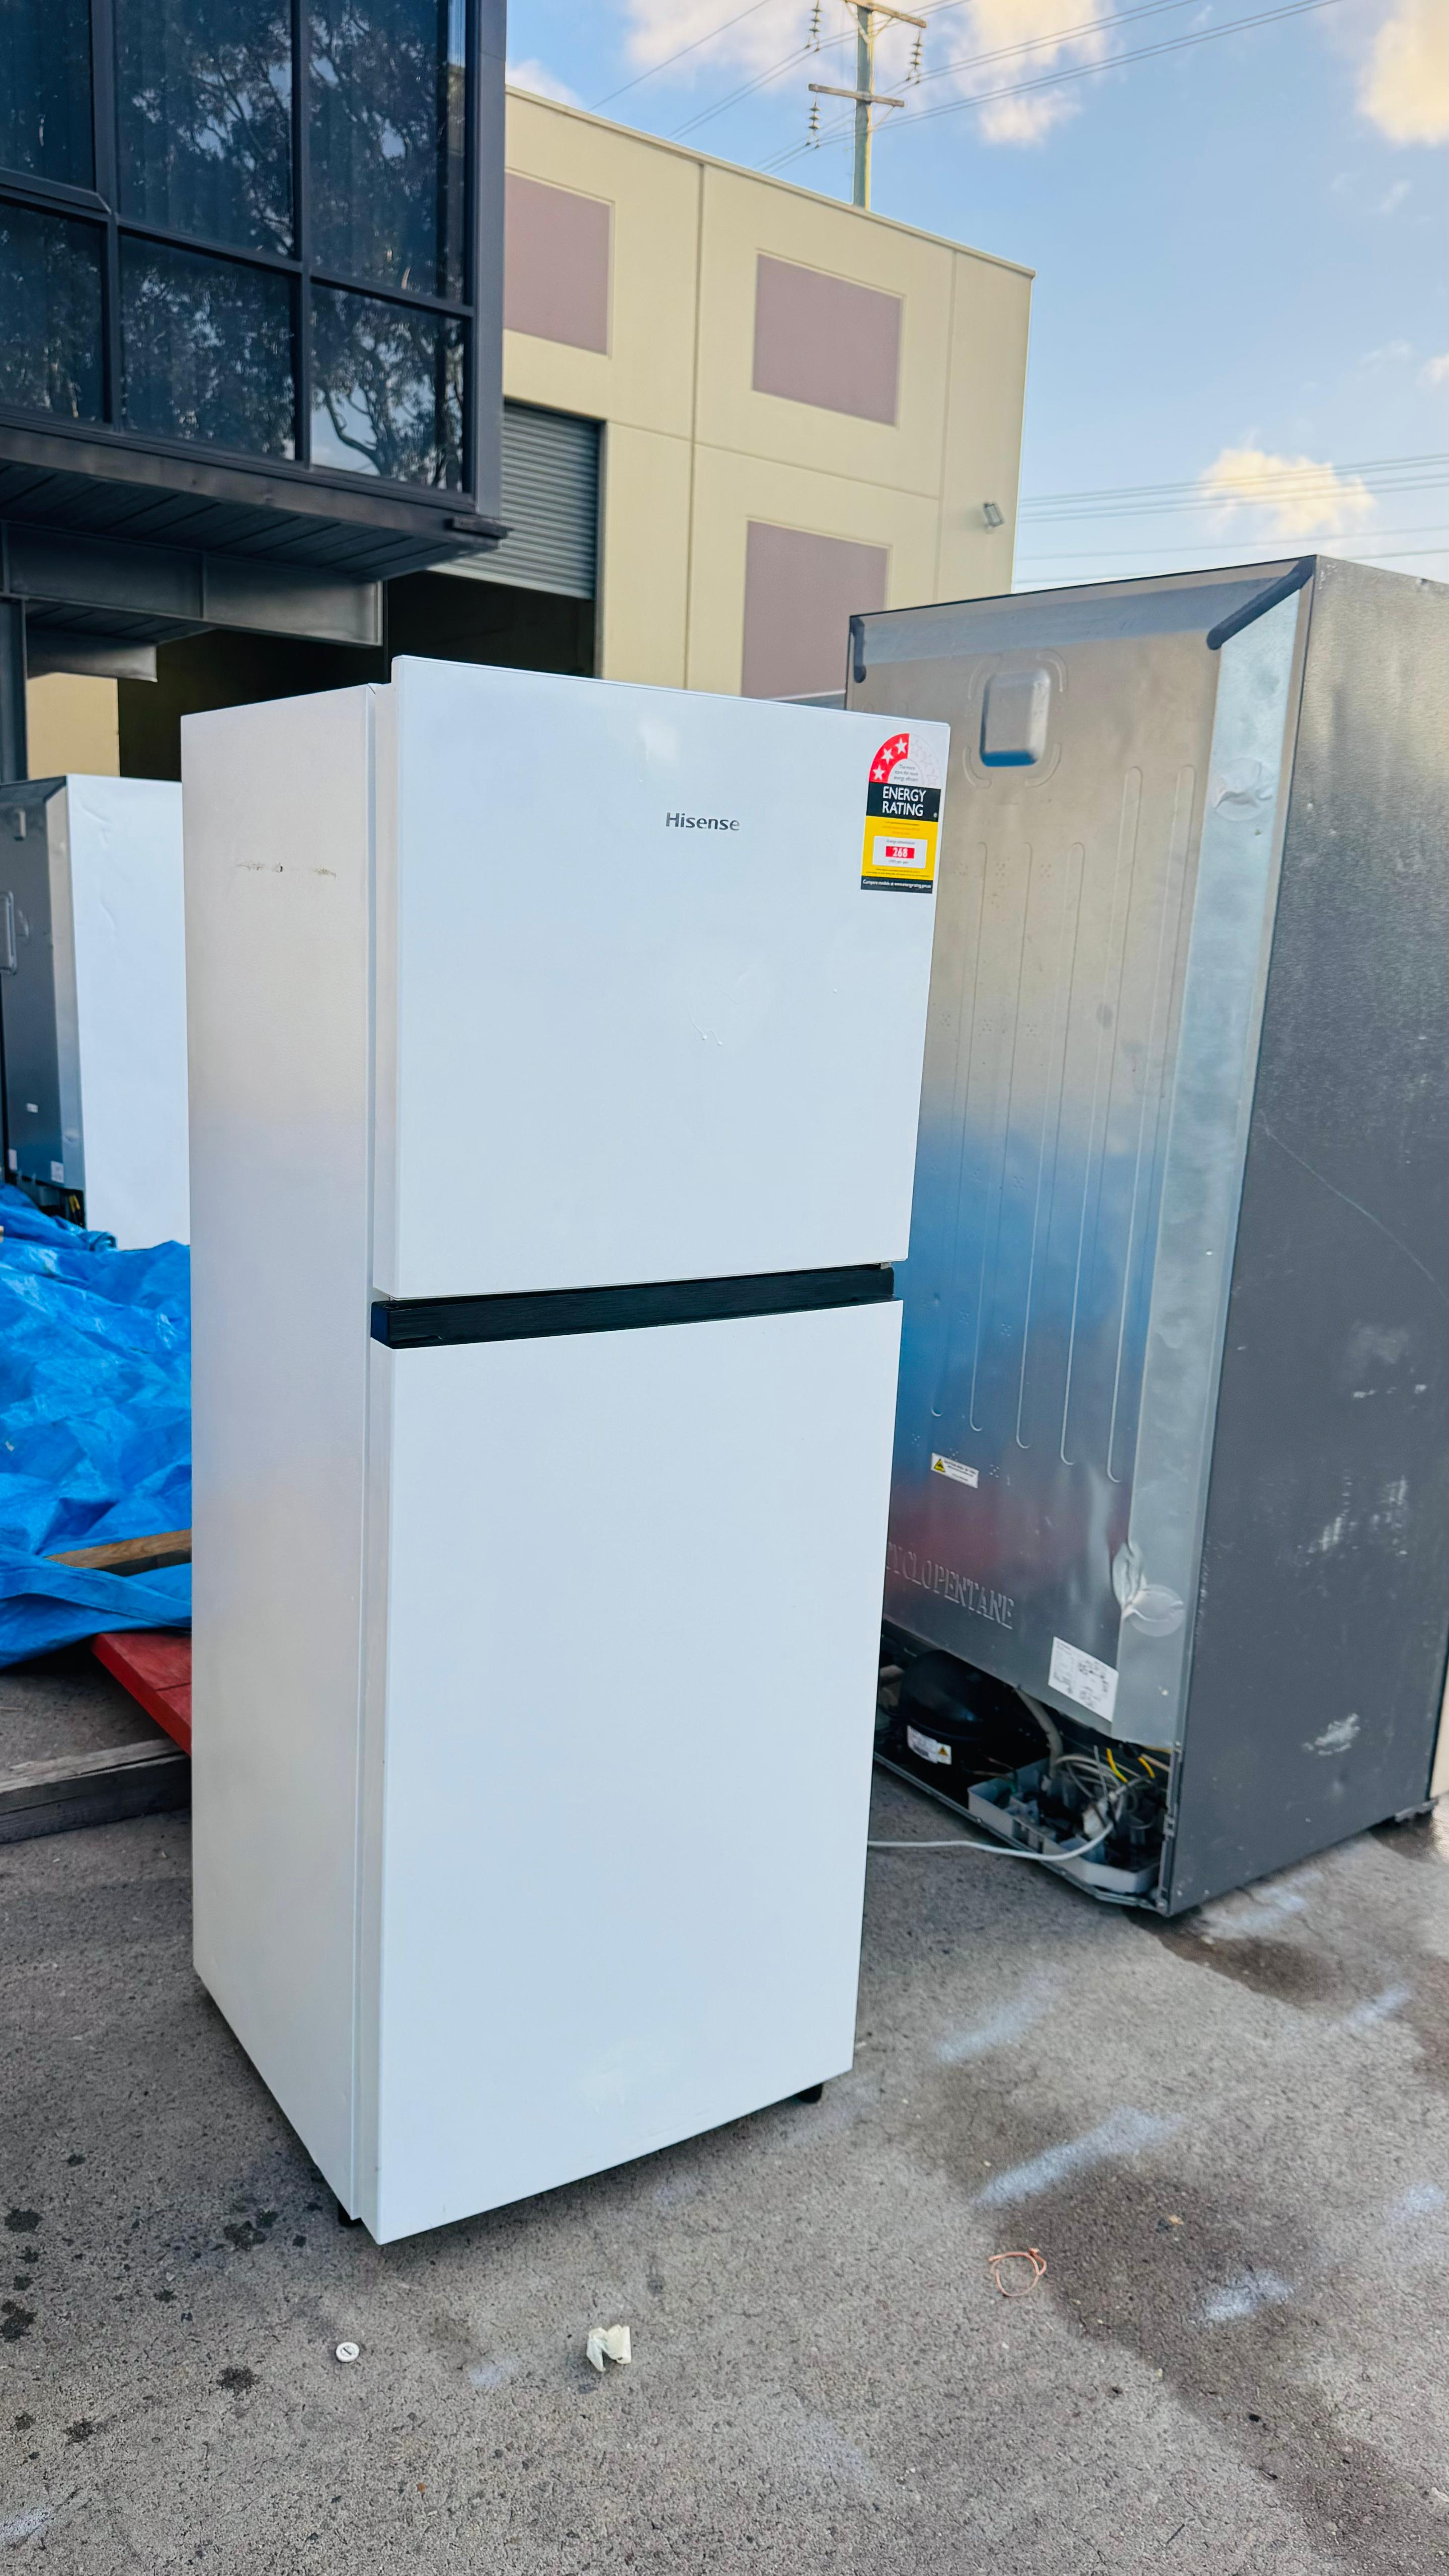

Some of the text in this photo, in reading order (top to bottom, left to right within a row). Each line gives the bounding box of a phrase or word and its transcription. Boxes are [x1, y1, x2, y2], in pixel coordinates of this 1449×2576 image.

[882, 786, 926, 802] ENERGY
[882, 800, 924, 817] RATING
[666, 812, 740, 831] Hisense
[893, 847, 908, 858] 268
